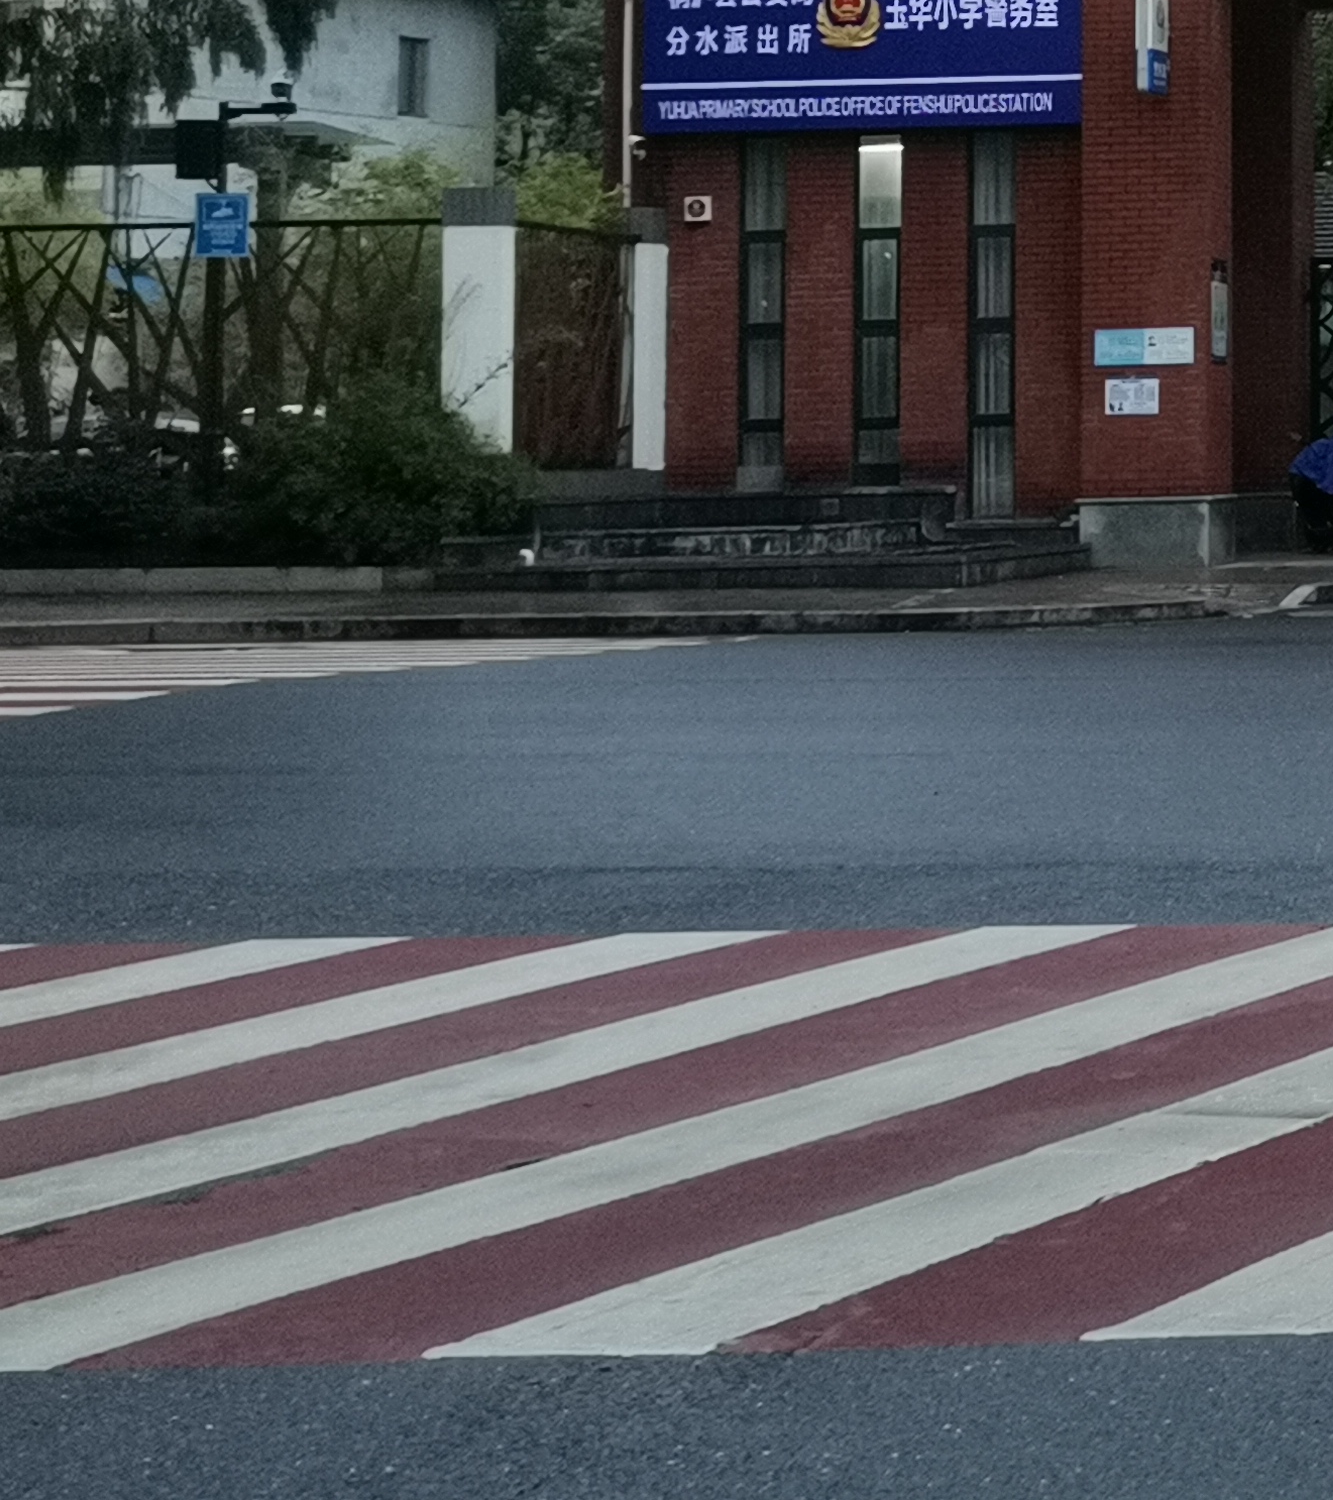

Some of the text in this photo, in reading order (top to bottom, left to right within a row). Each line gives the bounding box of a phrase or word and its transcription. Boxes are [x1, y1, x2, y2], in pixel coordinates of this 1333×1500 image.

[665, 22, 813, 56] 分水派出所
[751, 98, 799, 118] SCHOOL
[799, 97, 841, 117] POLICE
[842, 96, 884, 116] OFFICE
[885, 96, 902, 115] OF
[998, 92, 1054, 113] STATION
